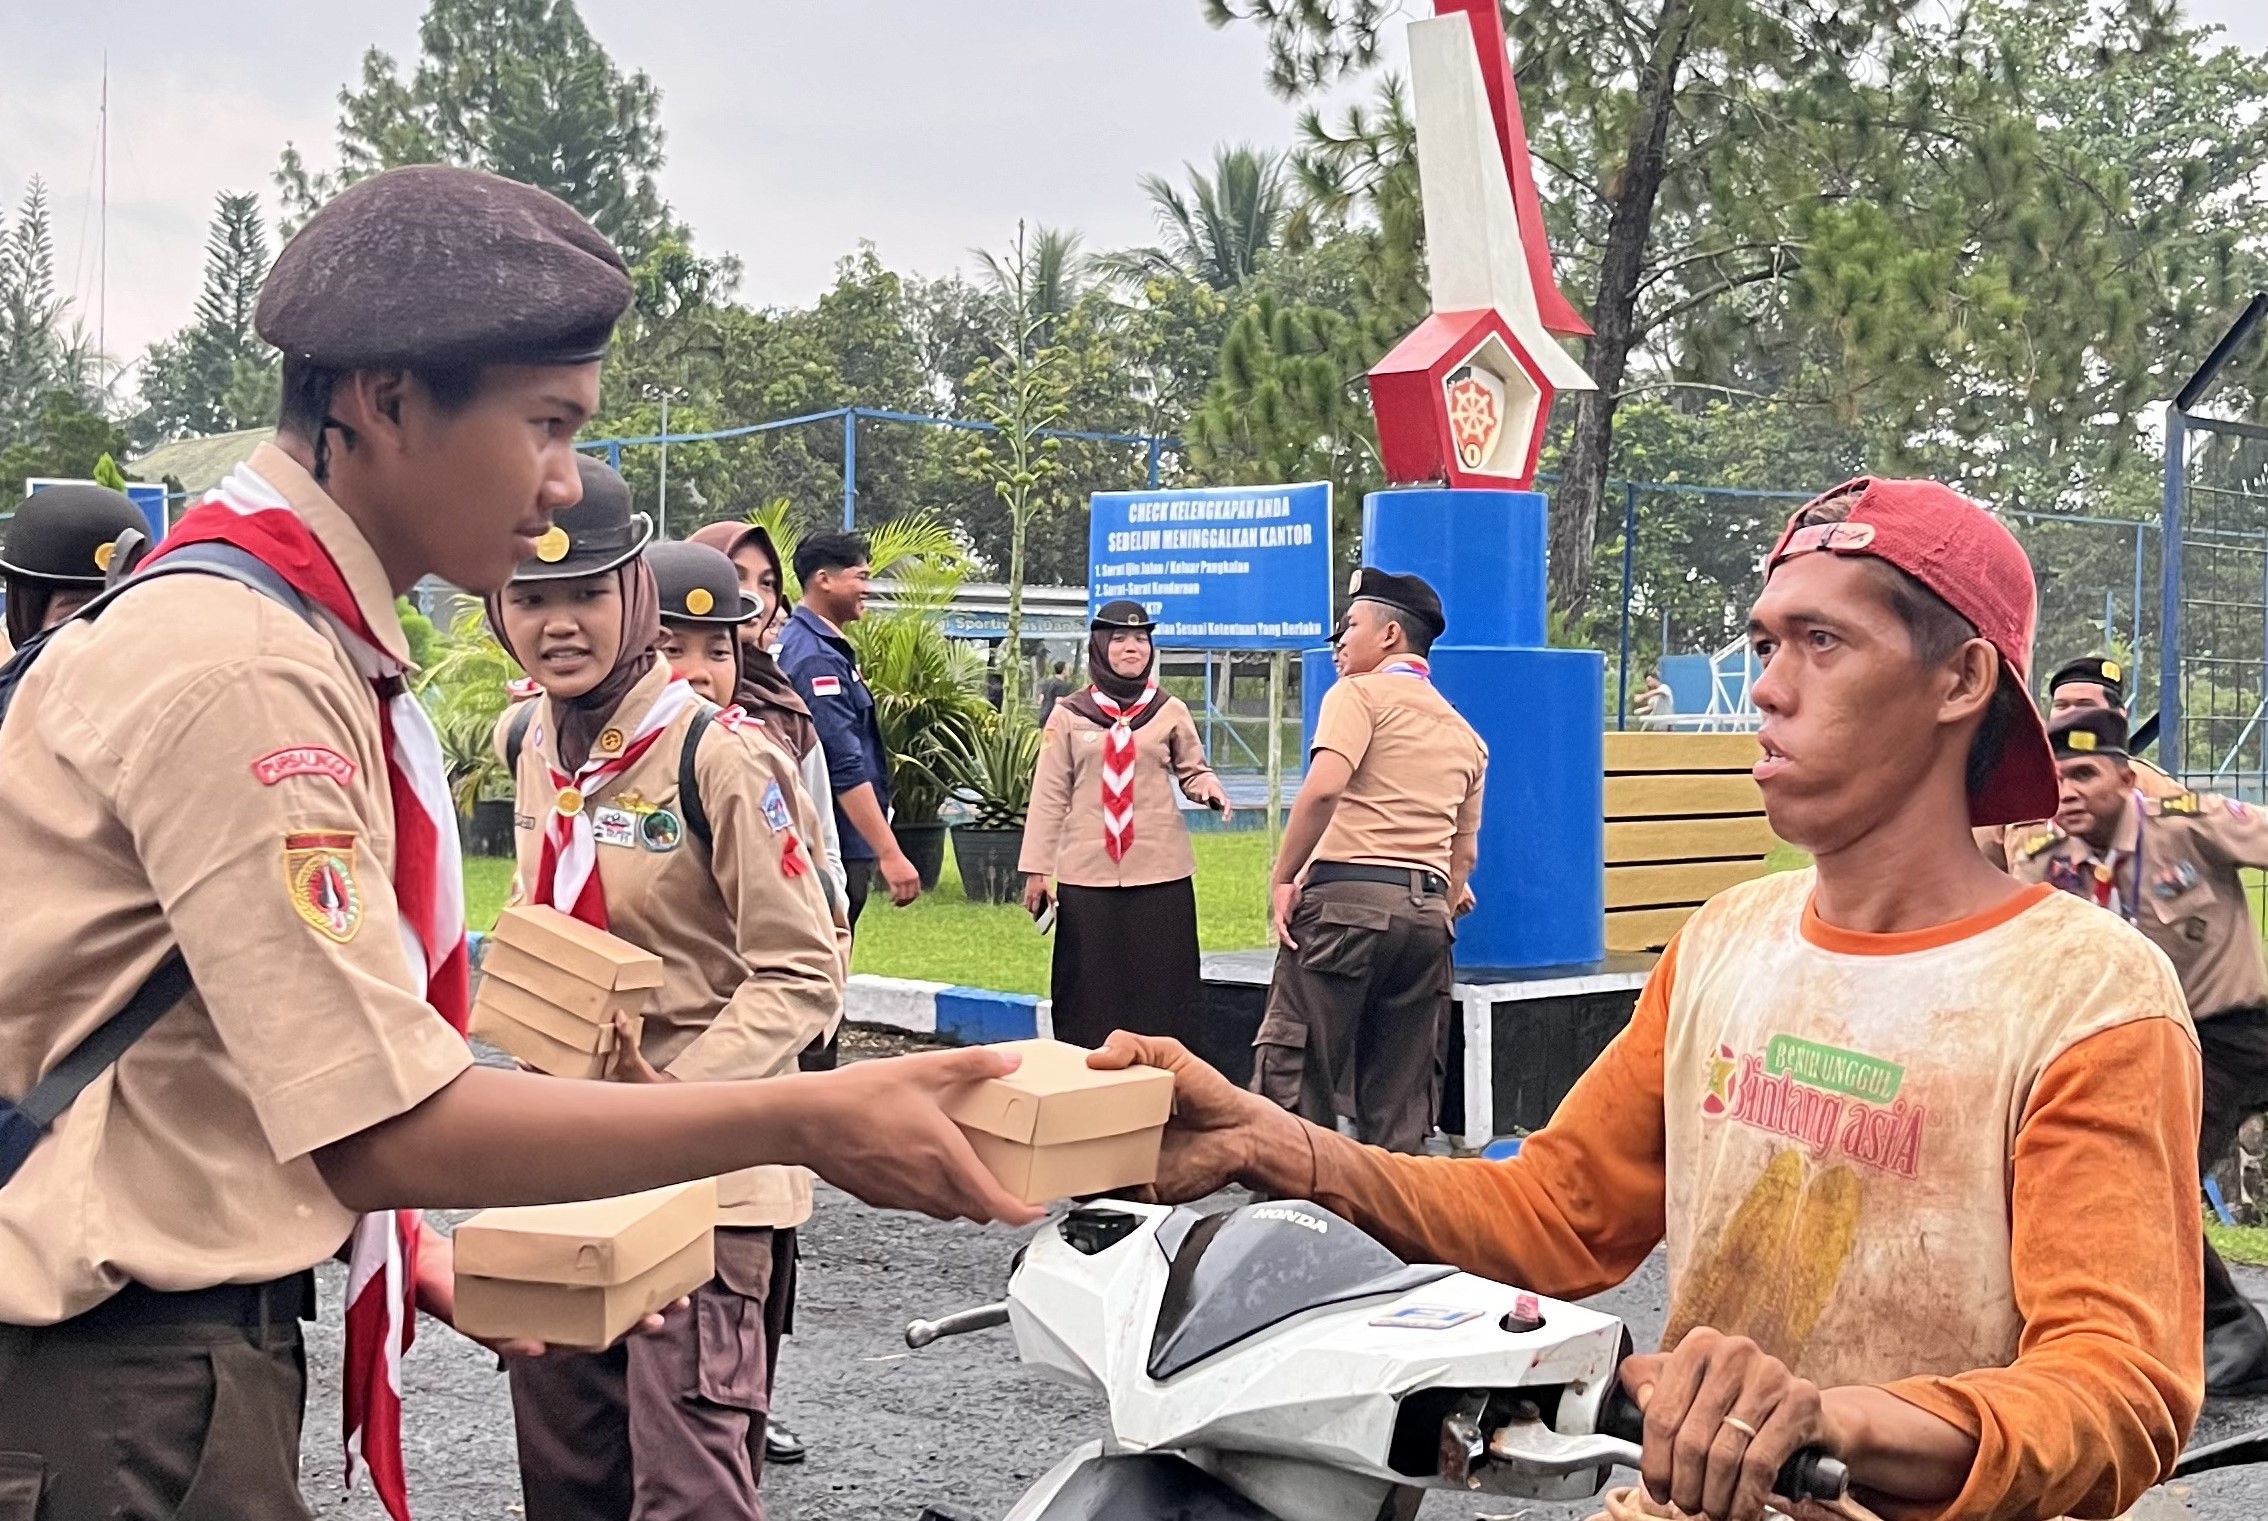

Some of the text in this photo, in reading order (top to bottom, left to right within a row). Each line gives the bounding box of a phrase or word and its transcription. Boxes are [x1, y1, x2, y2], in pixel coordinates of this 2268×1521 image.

[1128, 497, 1290, 523] CHECK KELENGKAPAN ANDA
[1108, 524, 1312, 552] SEBELUM MENINGGALKAN KANTOR
[1200, 560, 1249, 575] Pangkalan
[1257, 621, 1281, 637] Yang
[1281, 621, 1321, 636] Berlaku
[1822, 1053, 1893, 1098] UNGGUL
[1252, 1207, 1328, 1234] HONDA
